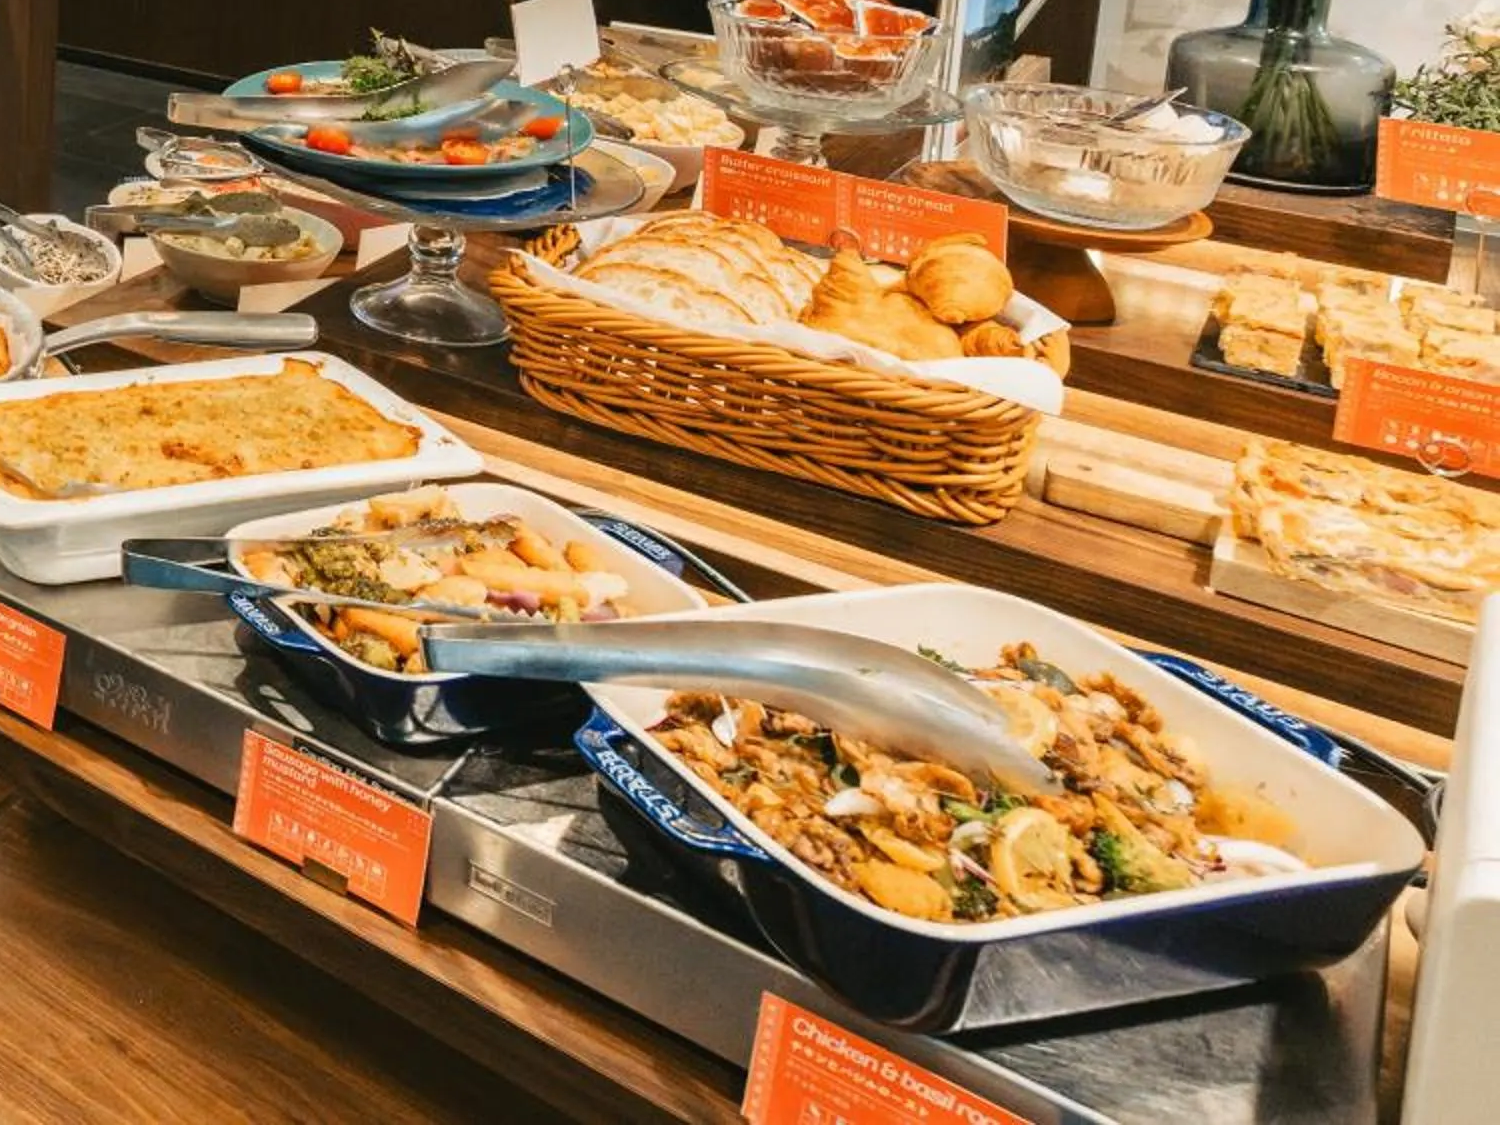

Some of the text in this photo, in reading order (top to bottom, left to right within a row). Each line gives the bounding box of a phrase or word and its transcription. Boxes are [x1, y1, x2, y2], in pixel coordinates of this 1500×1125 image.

[320, 768, 349, 791] with
[350, 781, 392, 813] honey
[792, 1017, 879, 1072] Chicken
[879, 1061, 899, 1082] &
[900, 1070, 956, 1111] basil
